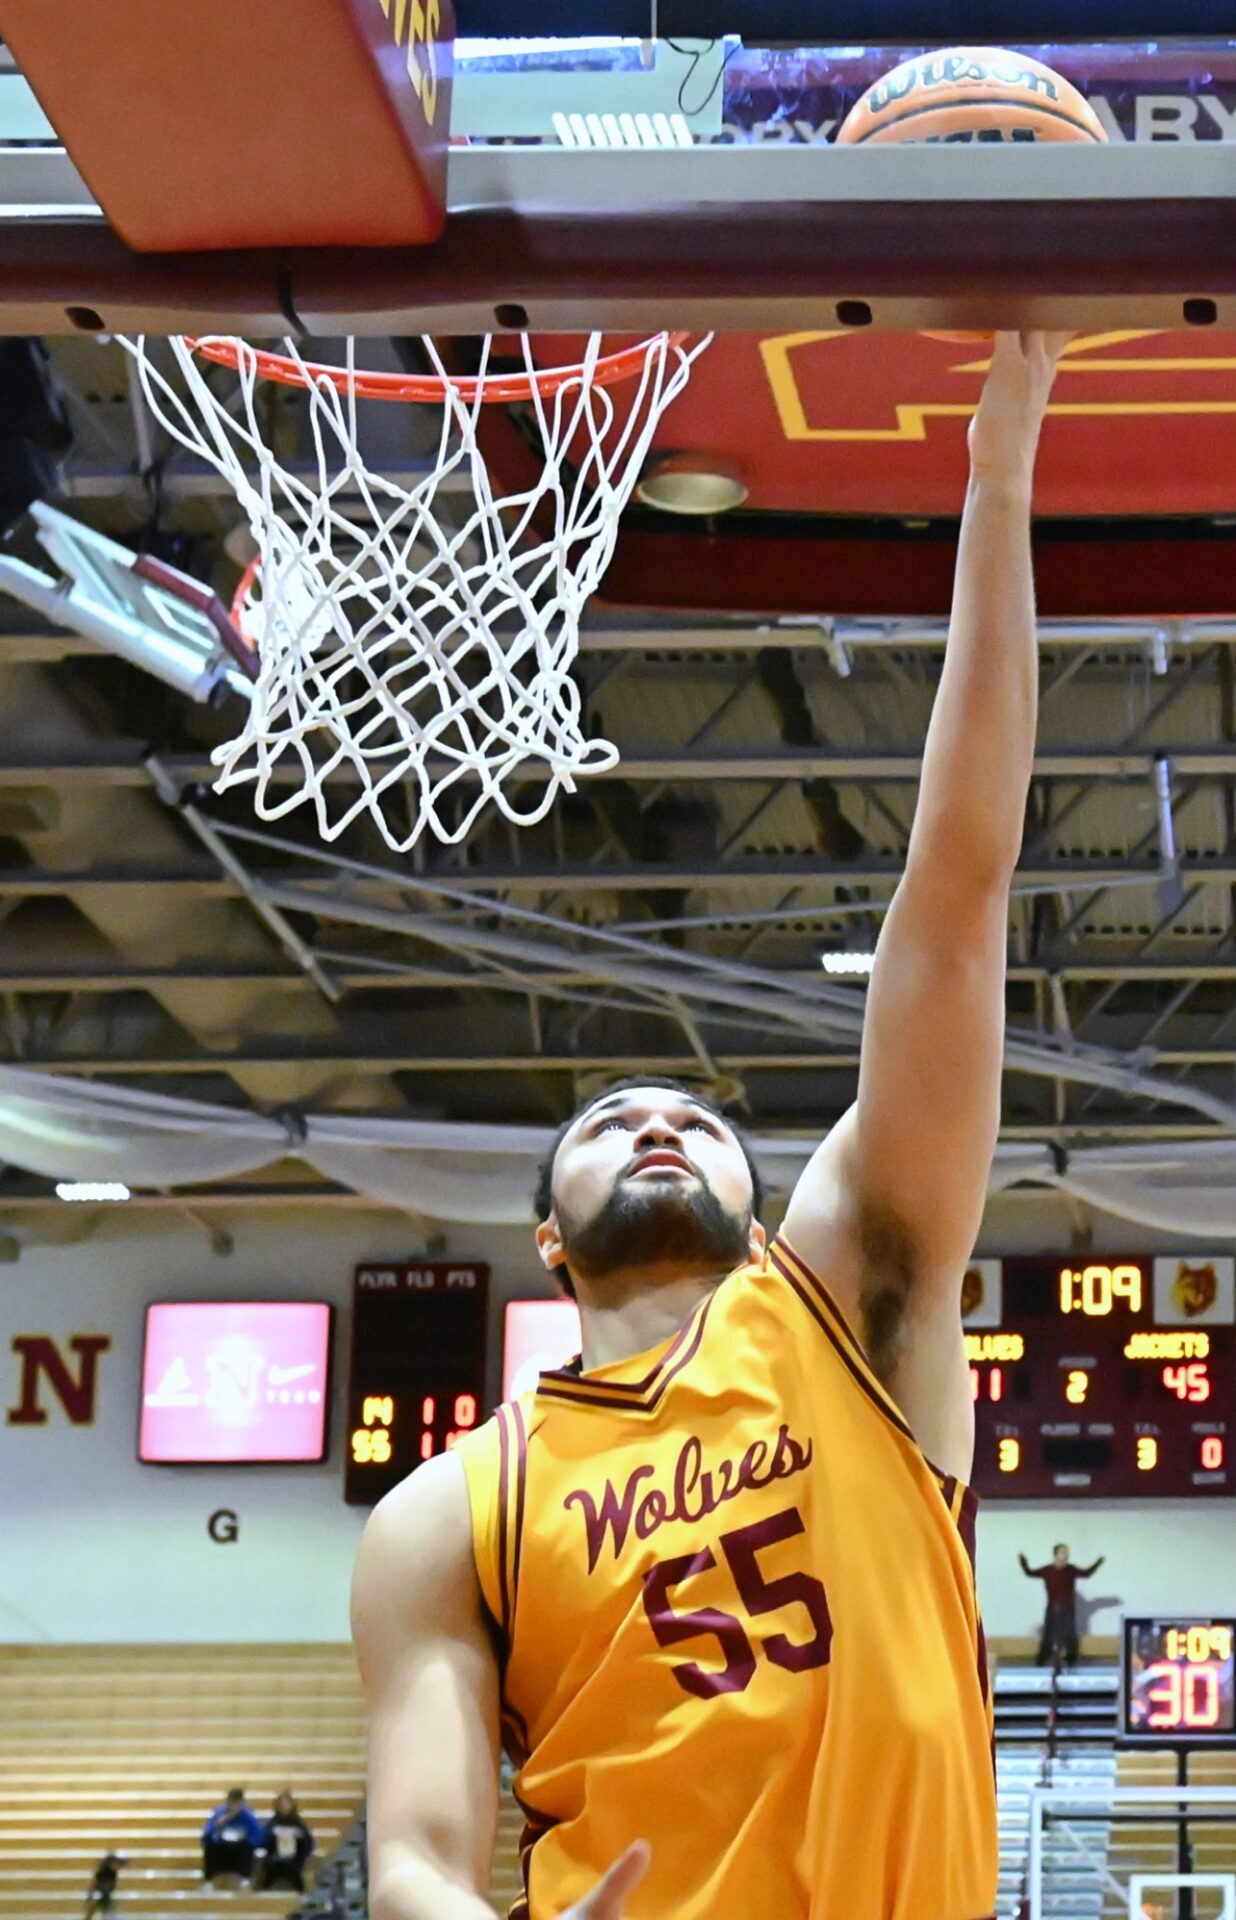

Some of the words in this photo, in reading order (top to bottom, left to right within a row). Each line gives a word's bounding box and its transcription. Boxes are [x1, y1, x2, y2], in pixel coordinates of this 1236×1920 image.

[868, 56, 1059, 113] Wilson
[1060, 1266, 1141, 1316] 1:09
[6, 1334, 111, 1427] N
[1066, 1371, 1088, 1403] 2
[1163, 1363, 1210, 1402] 45
[423, 1396, 434, 1425] 1
[454, 1394, 476, 1427] 0
[421, 1431, 433, 1460] 1
[999, 1438, 1019, 1472] 3
[1137, 1437, 1157, 1470] 3
[1202, 1437, 1222, 1469] 0
[564, 1424, 813, 1576] Wolves
[208, 1508, 239, 1545] G
[642, 1506, 834, 1700] 55
[1166, 1627, 1231, 1663] 1:09
[1148, 1664, 1219, 1727] 30
